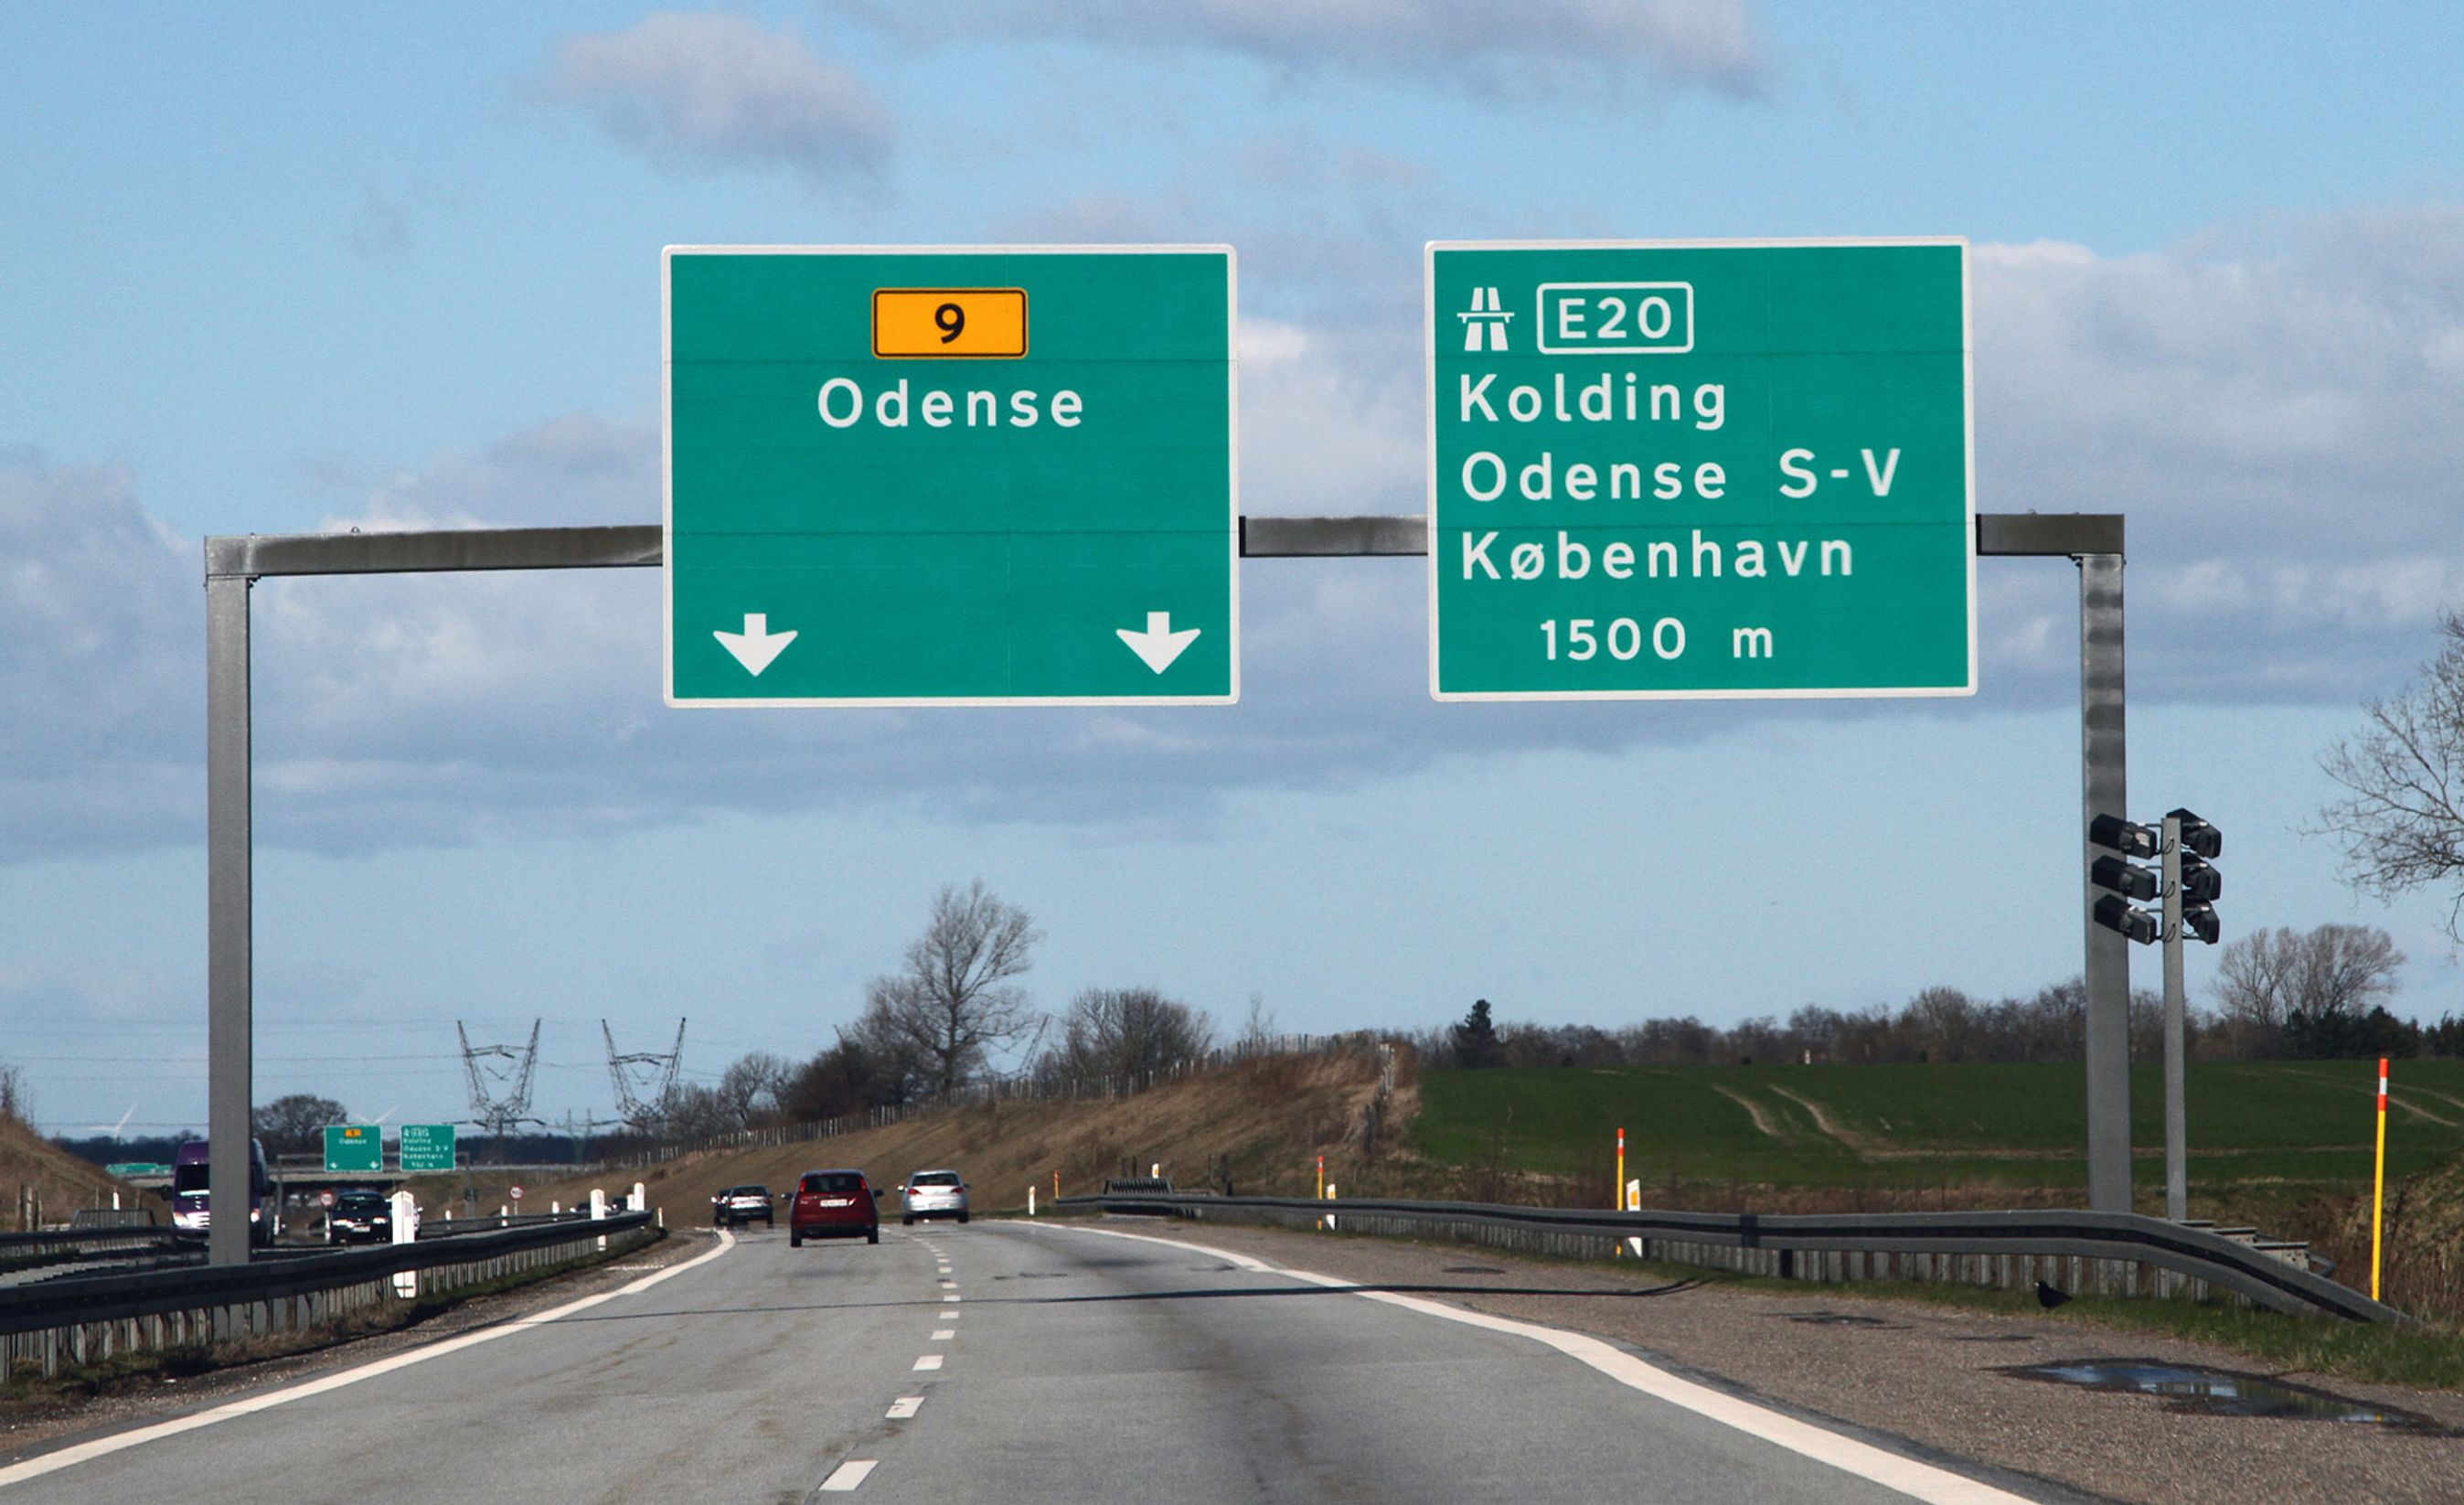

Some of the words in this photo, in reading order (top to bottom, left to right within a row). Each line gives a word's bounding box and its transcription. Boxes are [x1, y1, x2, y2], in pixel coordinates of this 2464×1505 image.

[933, 303, 965, 344] 9
[1558, 296, 1673, 339] E20
[816, 377, 1084, 429] Odense
[1459, 372, 1726, 431] Kolding
[1461, 450, 1727, 502] Odense
[1778, 447, 1901, 498] S-V
[1461, 529, 1852, 581] København
[1540, 617, 1687, 661] 1500
[1732, 626, 1774, 659] m
